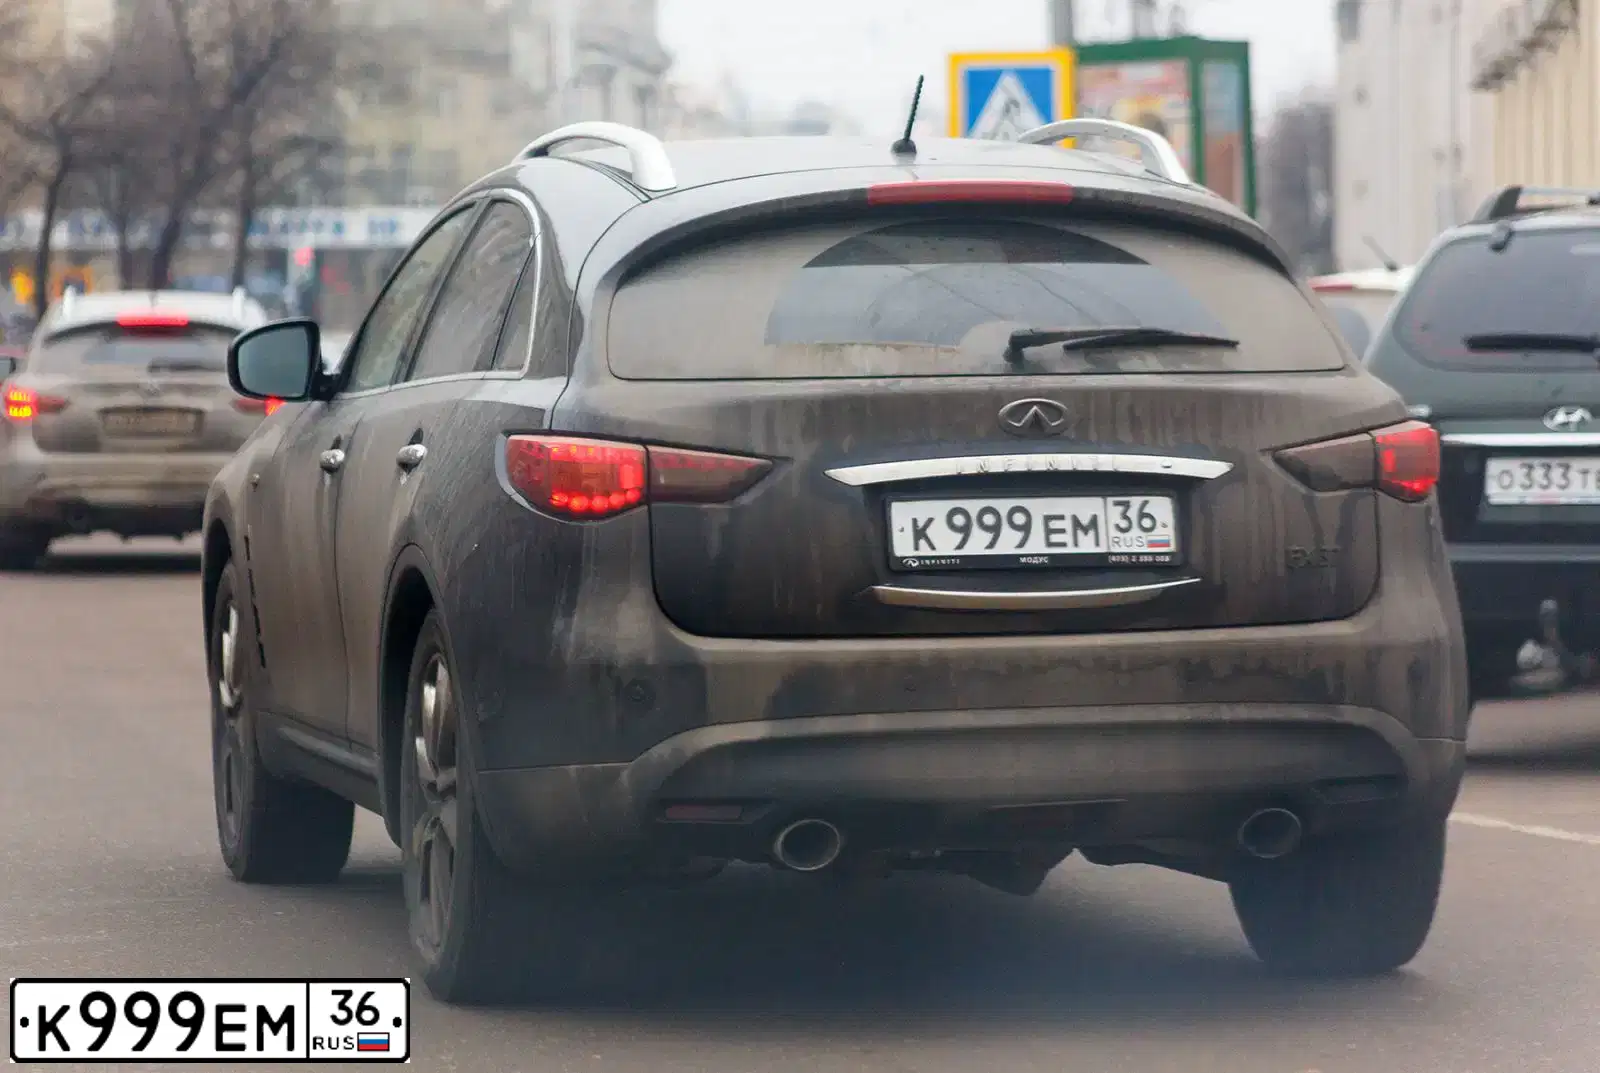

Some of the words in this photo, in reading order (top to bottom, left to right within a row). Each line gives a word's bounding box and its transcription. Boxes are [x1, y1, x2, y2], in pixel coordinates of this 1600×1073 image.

[957, 457, 1119, 474] INFINITI
[1112, 500, 1157, 533] 36
[1112, 535, 1145, 549] RUS
[920, 558, 960, 566] INFINITI
[1019, 556, 1048, 565] МОДУС
